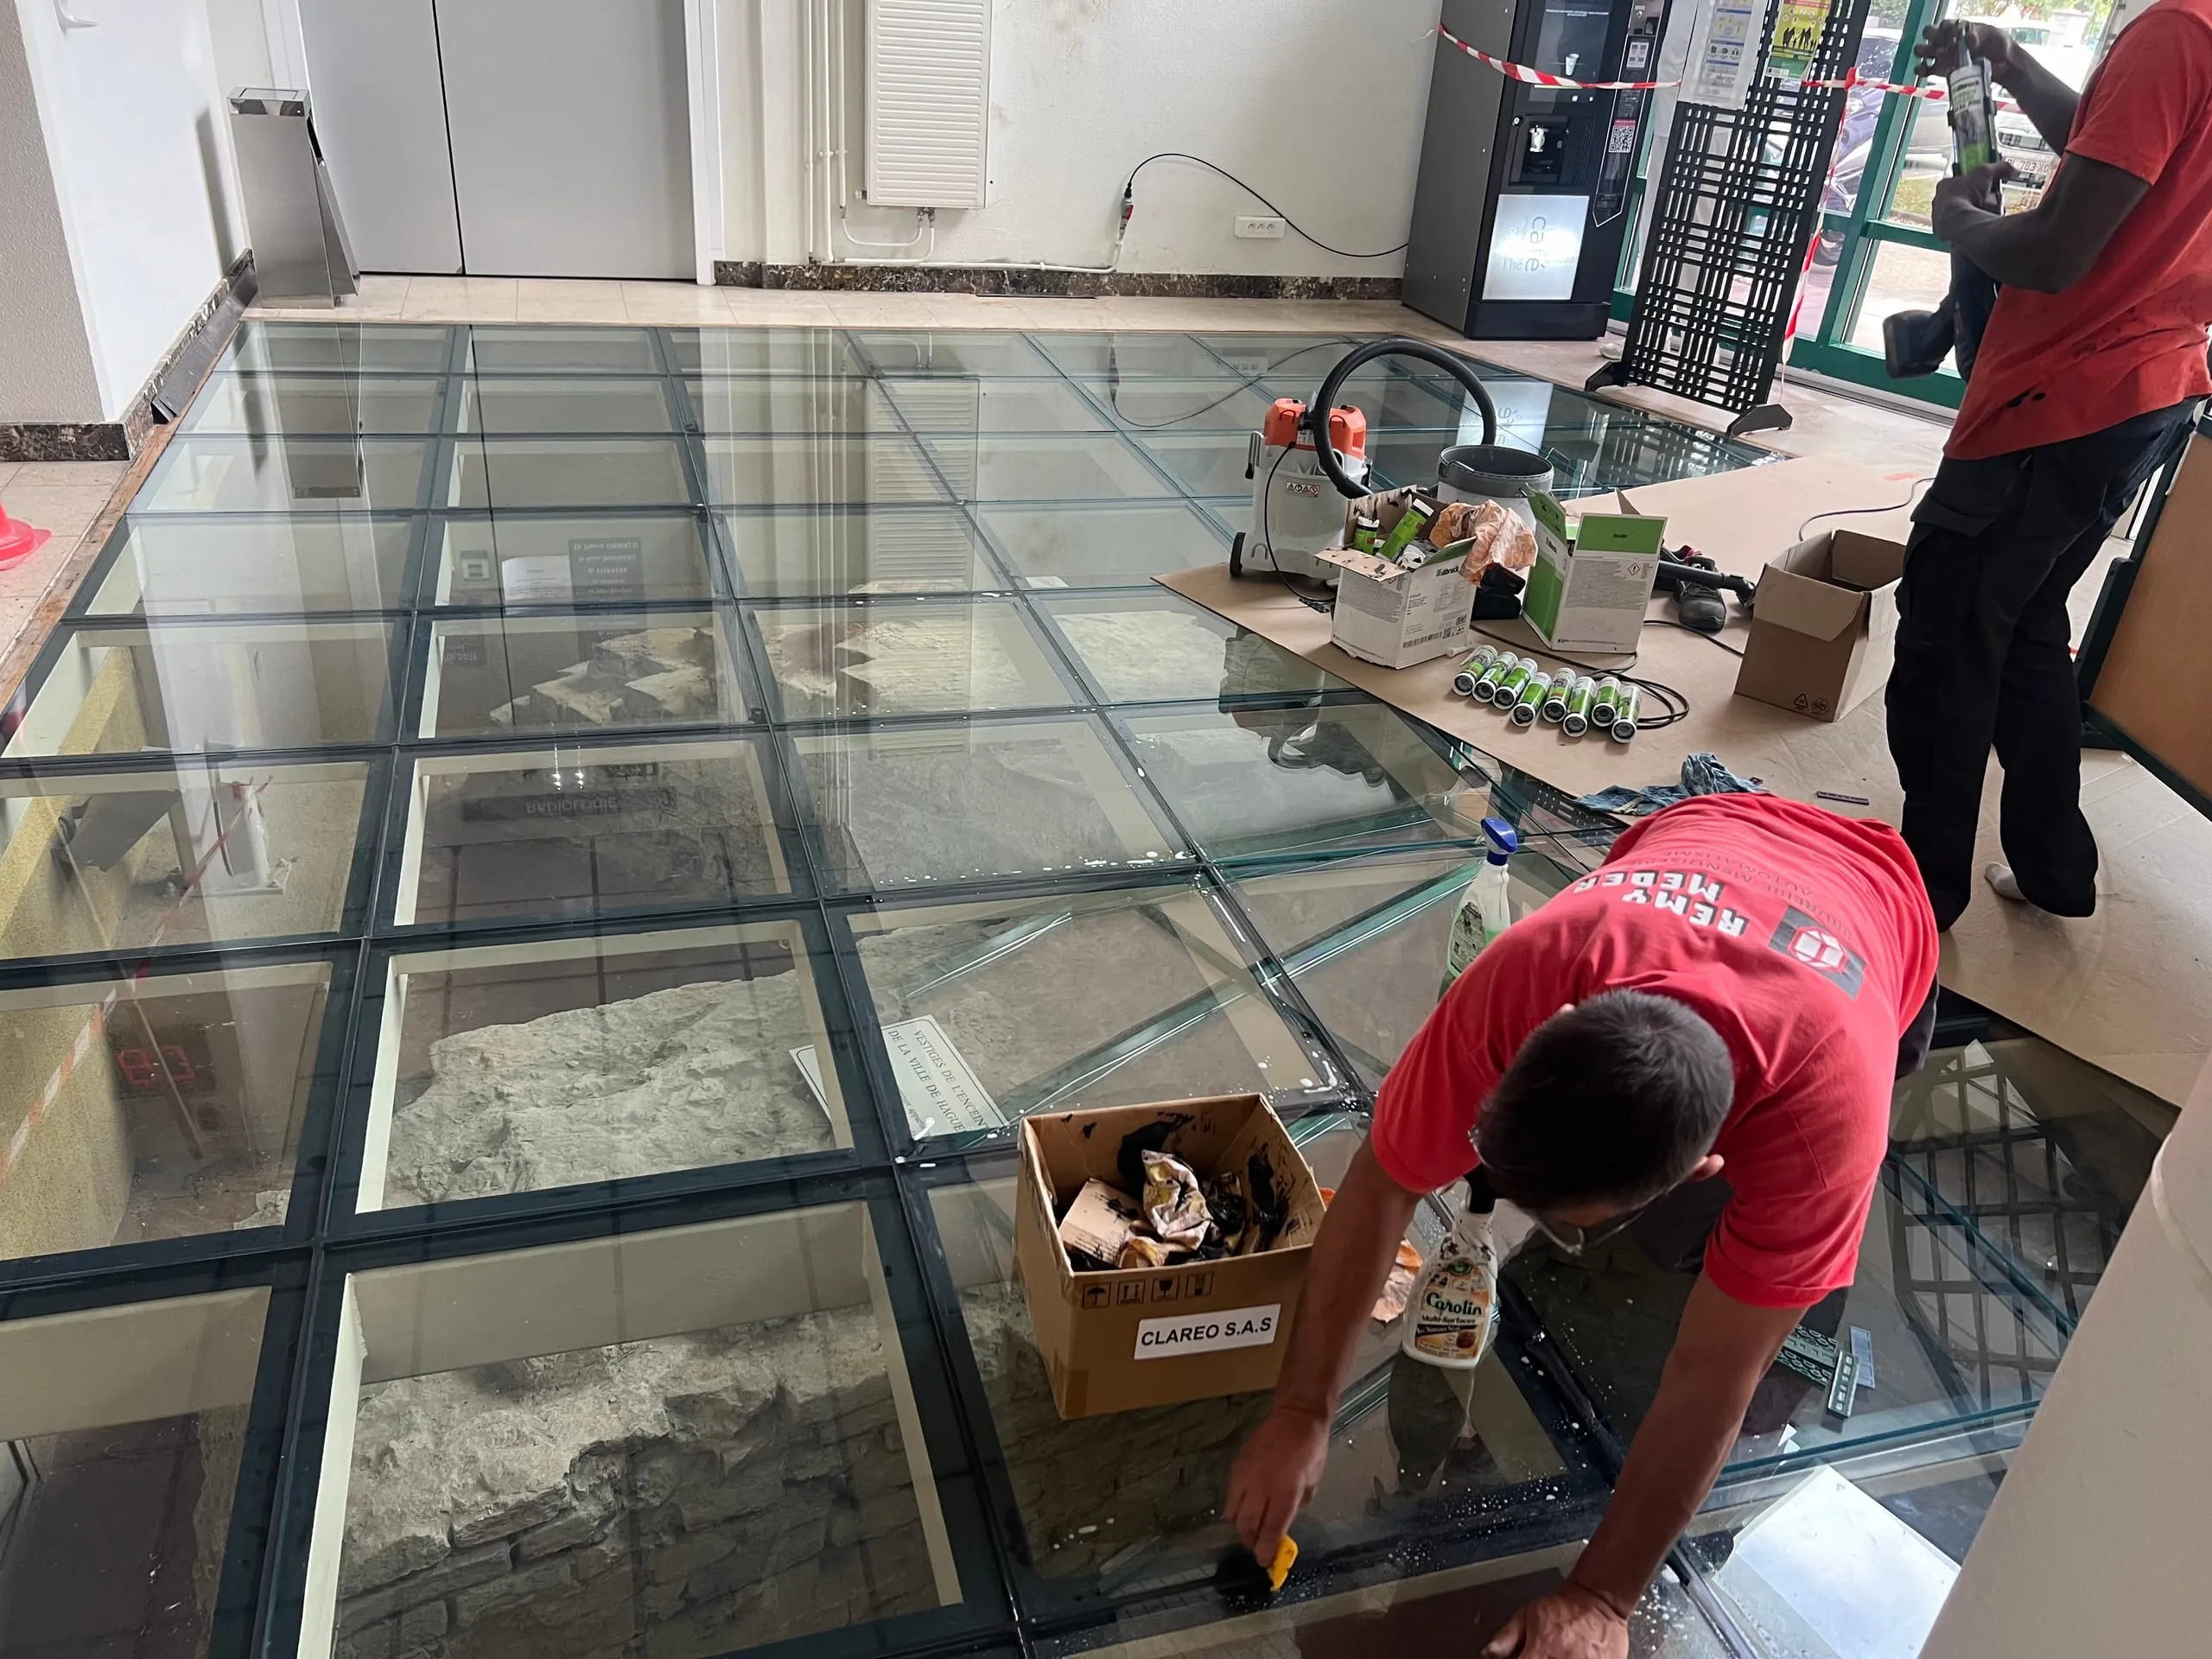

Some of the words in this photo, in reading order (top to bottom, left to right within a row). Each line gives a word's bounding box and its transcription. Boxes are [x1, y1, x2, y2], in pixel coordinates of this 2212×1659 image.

[1573, 869, 1725, 902] MEDER
[1622, 887, 1750, 938] REMY
[888, 1029, 903, 1043] DE
[899, 1044, 912, 1056] LA
[909, 1057, 931, 1083] VILLE
[926, 1084, 942, 1098] DE
[913, 1030, 946, 1069] VESTIGES
[941, 1070, 957, 1084] DE
[952, 1084, 988, 1128] L'ENCEIN
[1427, 1292, 1483, 1315] Carolin
[1141, 1324, 1219, 1346] CLAREO
[1224, 1317, 1272, 1337] S.A.S
